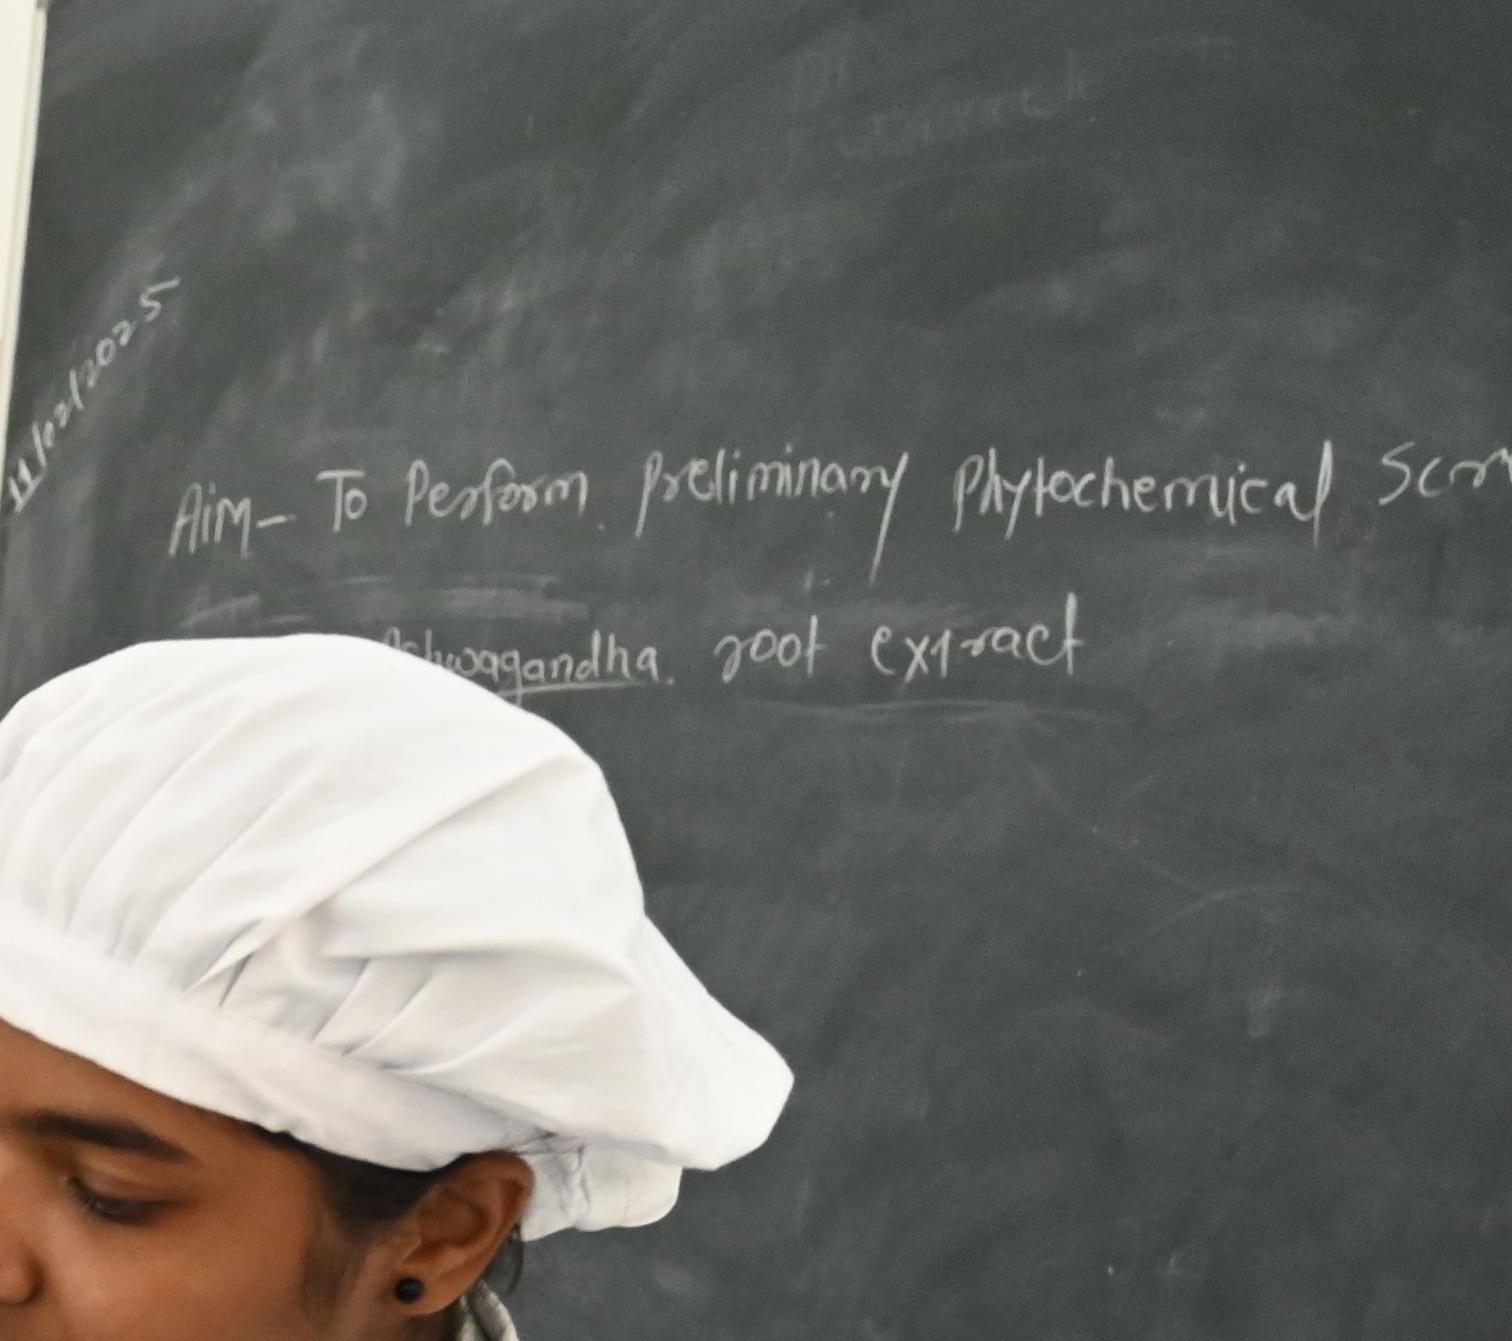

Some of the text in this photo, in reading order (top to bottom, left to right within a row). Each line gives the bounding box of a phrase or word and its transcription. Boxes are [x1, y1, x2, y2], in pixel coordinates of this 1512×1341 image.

[316, 469, 368, 532] To
[714, 614, 826, 683] root
[871, 591, 1085, 683] extract
